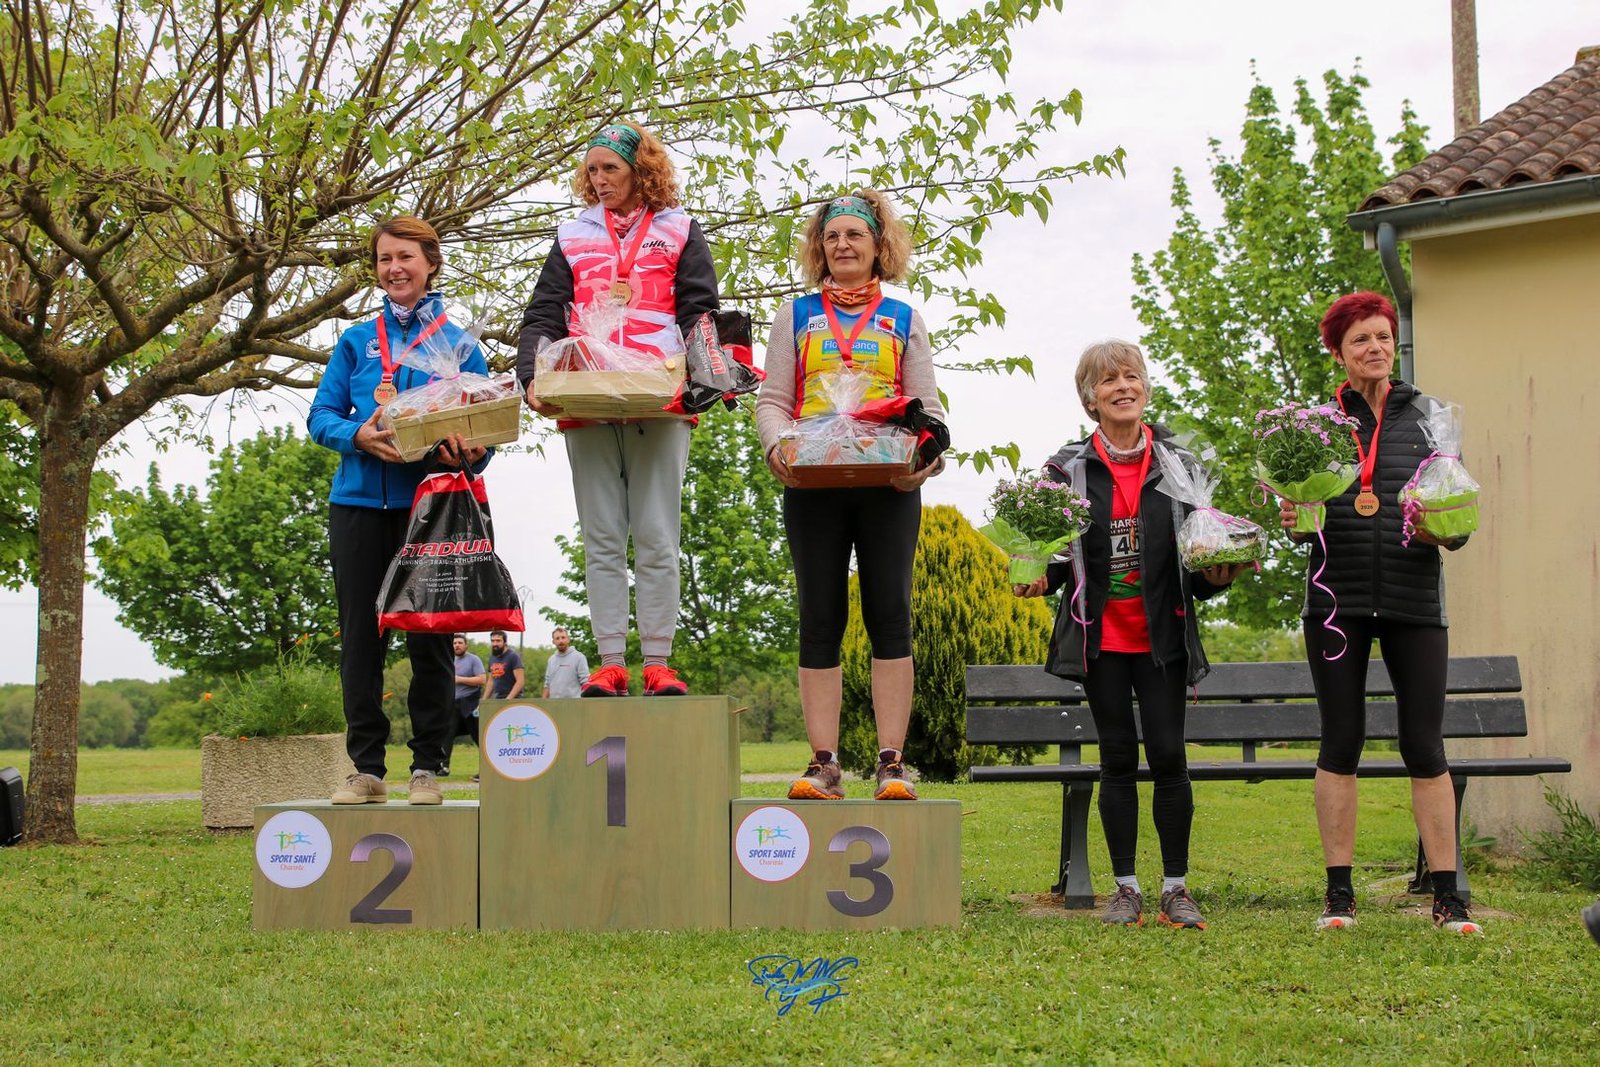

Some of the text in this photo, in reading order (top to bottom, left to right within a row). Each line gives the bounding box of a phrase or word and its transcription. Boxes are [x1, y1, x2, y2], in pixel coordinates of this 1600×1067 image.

[498, 743, 546, 757] SPORT SANTÉ
[585, 736, 626, 826] 1
[270, 851, 317, 863] SPORT SANTÉ
[349, 832, 414, 924] 2
[748, 846, 796, 858] SPORT SANTÉ
[826, 825, 894, 917] 3
